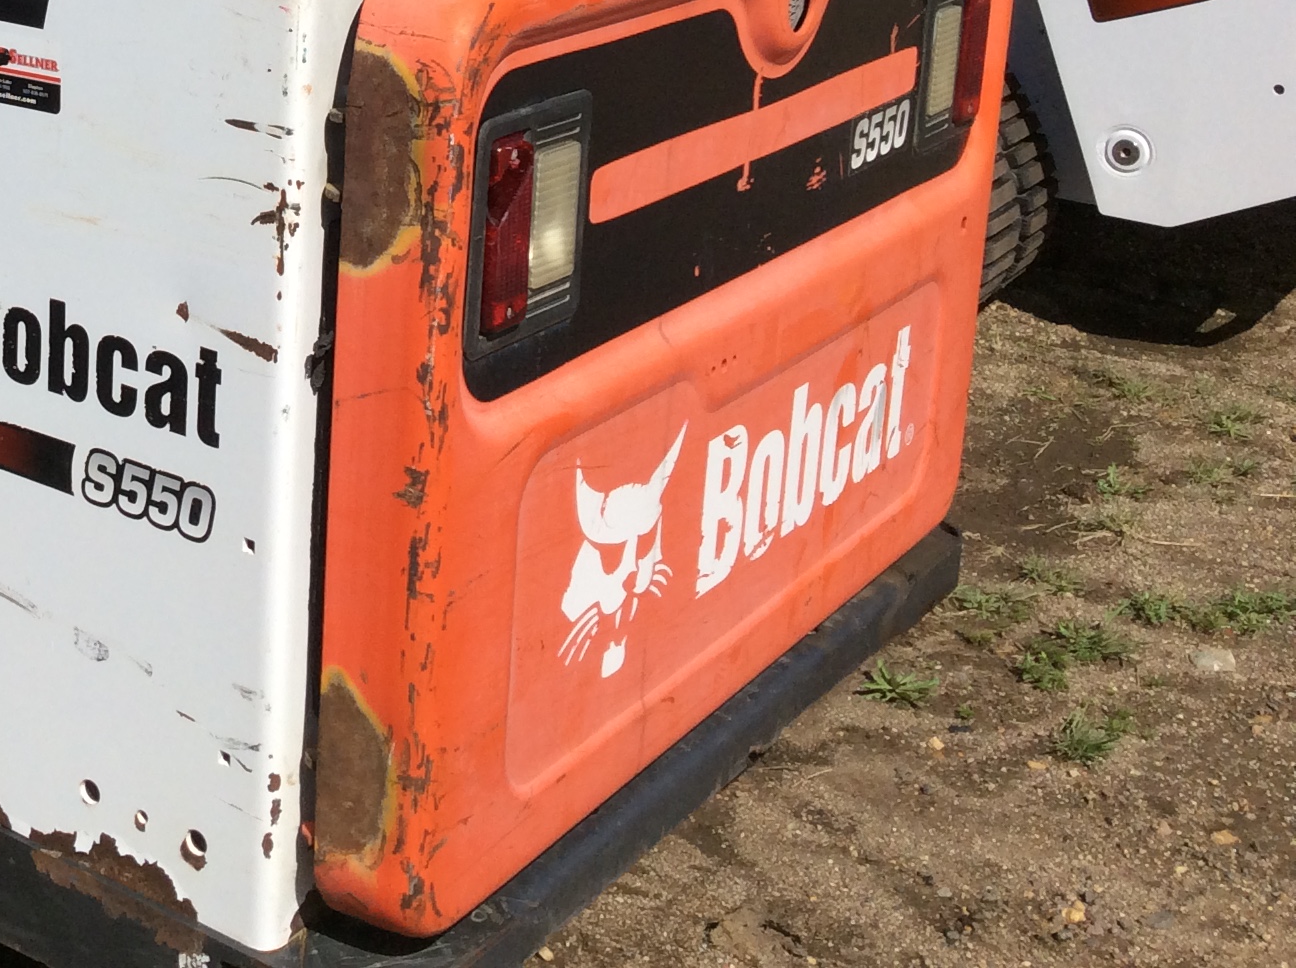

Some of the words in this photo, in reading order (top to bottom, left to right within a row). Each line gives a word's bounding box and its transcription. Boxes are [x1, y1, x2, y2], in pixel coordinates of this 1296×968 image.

[9, 47, 60, 72] SELLNER
[851, 98, 911, 170] S550
[81, 447, 217, 543] S550
[695, 325, 913, 599] Bobcat
